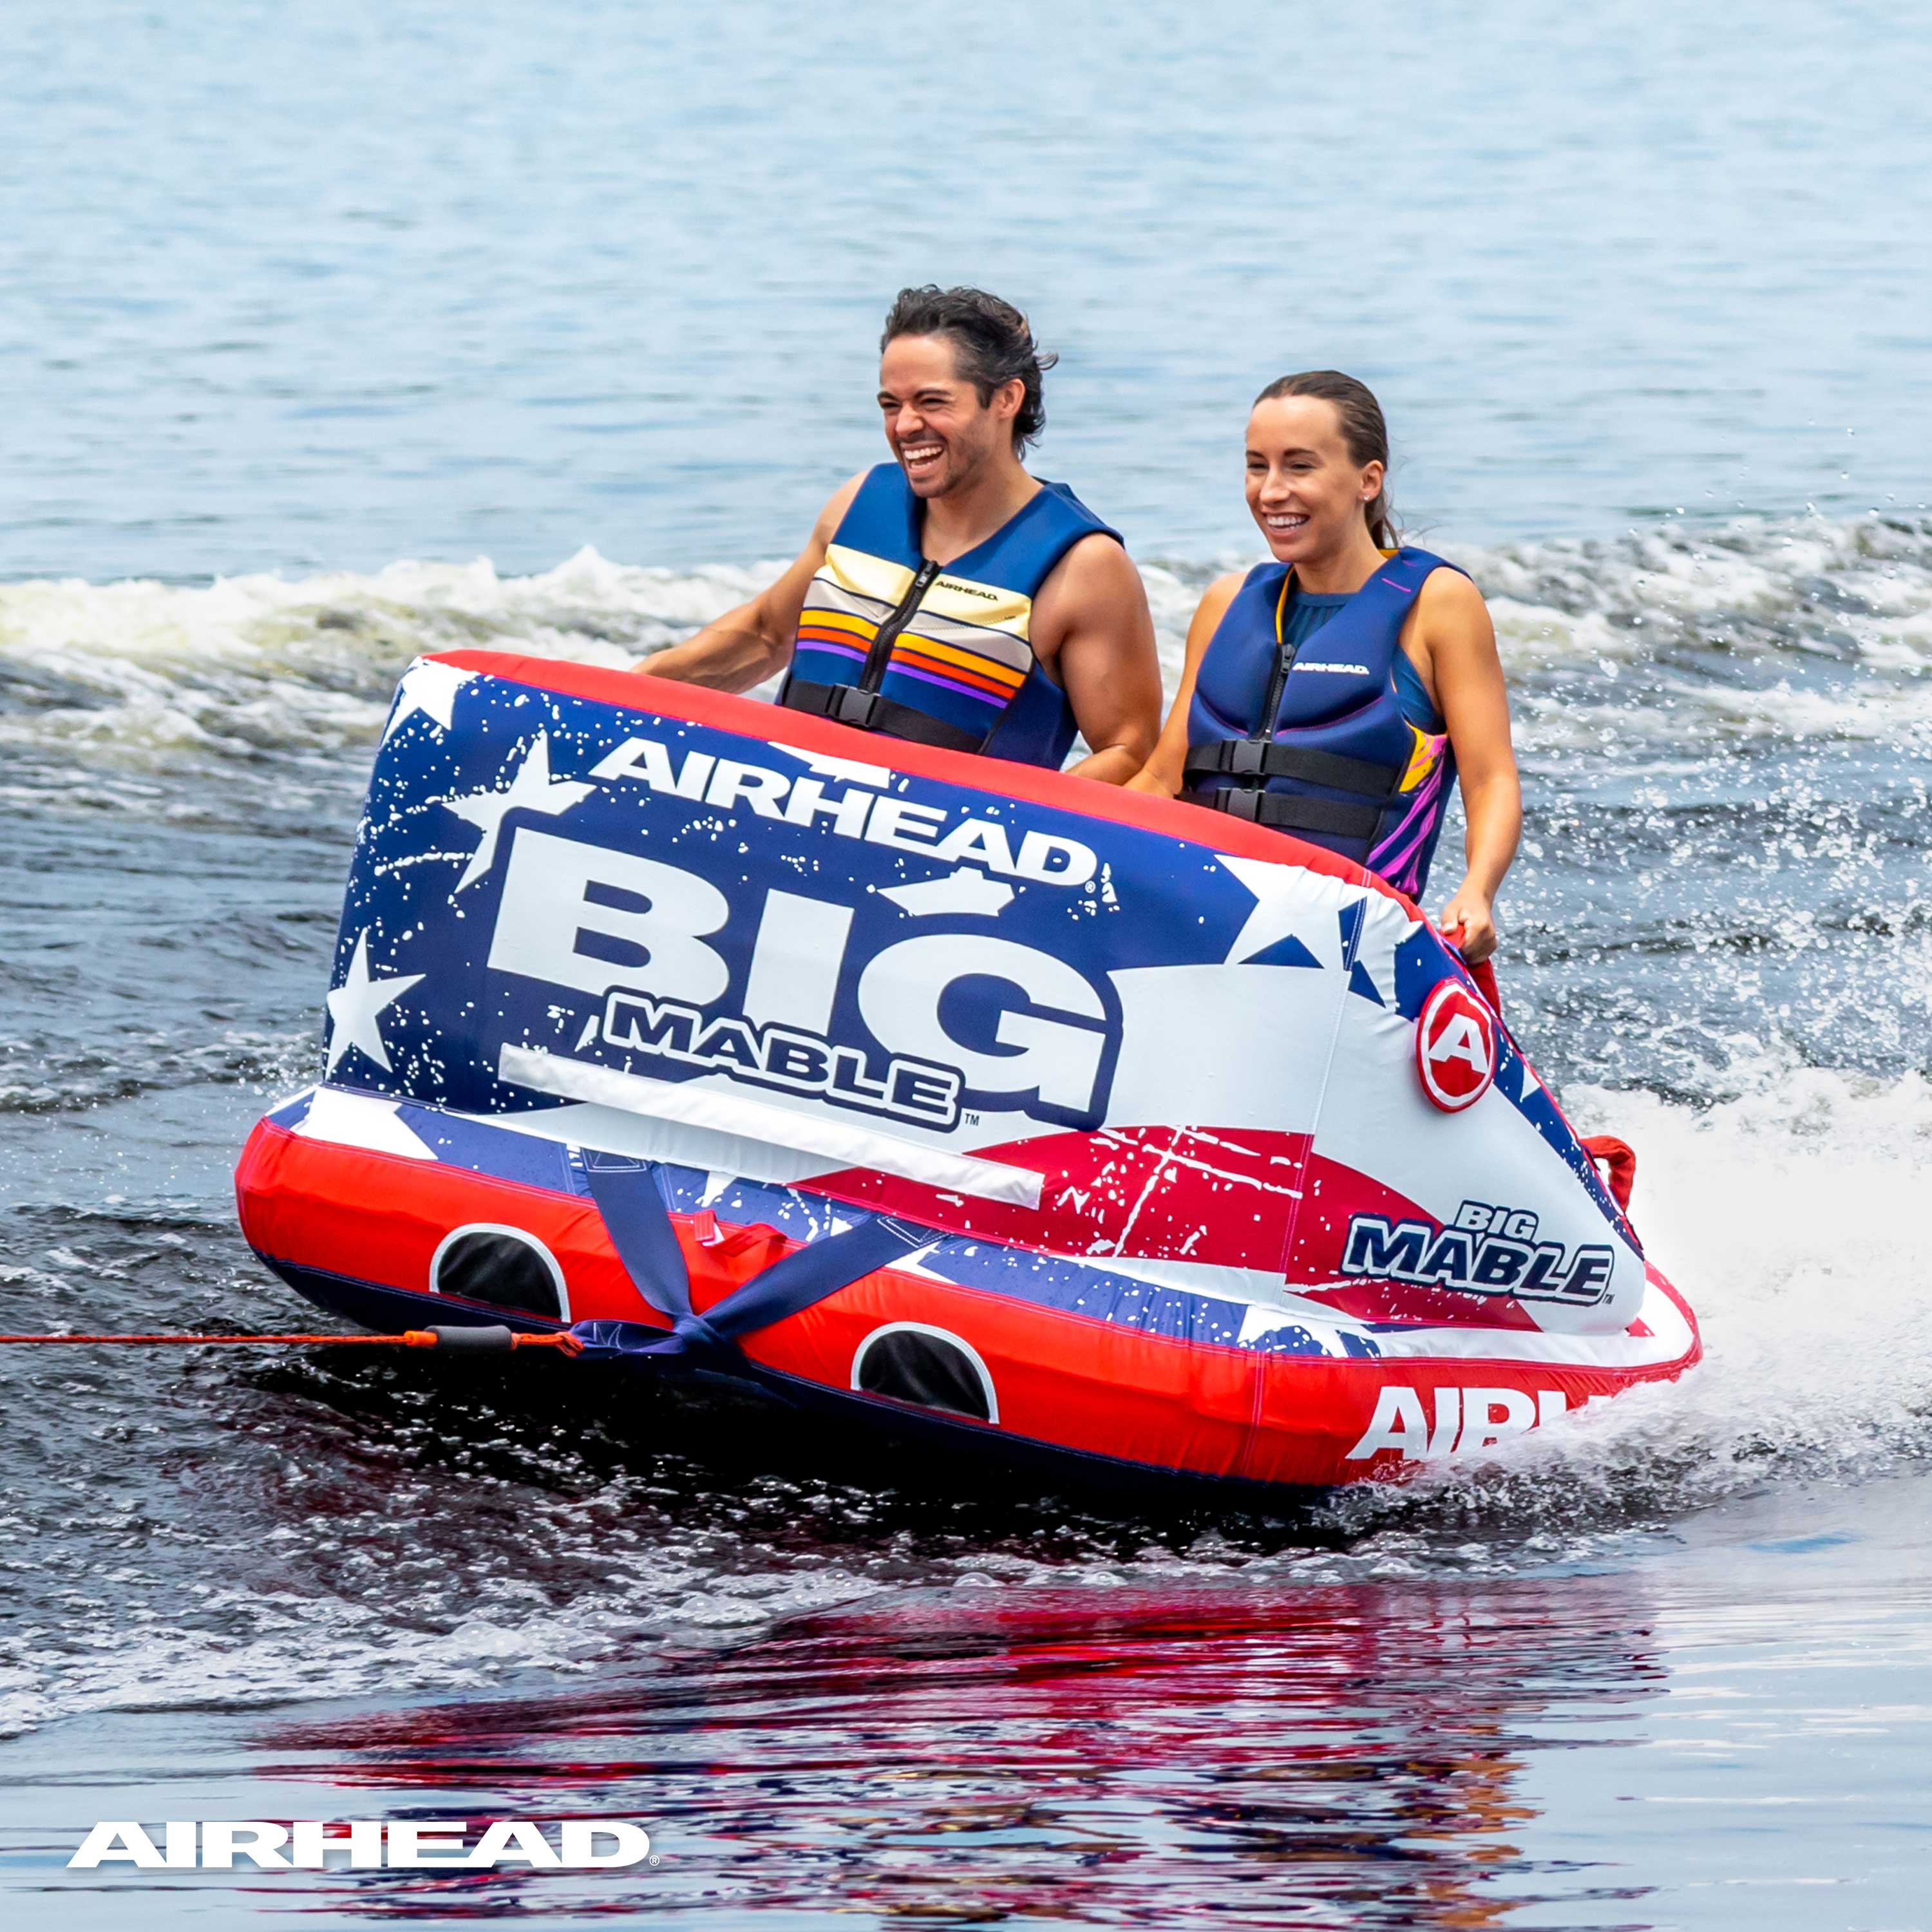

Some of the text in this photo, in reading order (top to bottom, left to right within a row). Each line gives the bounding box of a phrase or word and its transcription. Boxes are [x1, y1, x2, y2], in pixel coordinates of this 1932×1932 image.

[486, 826, 1107, 1113] BIG
[605, 994, 958, 1121] MABLE
[1345, 1218, 1612, 1302] MABLE
[1455, 1204, 1538, 1240] BIG
